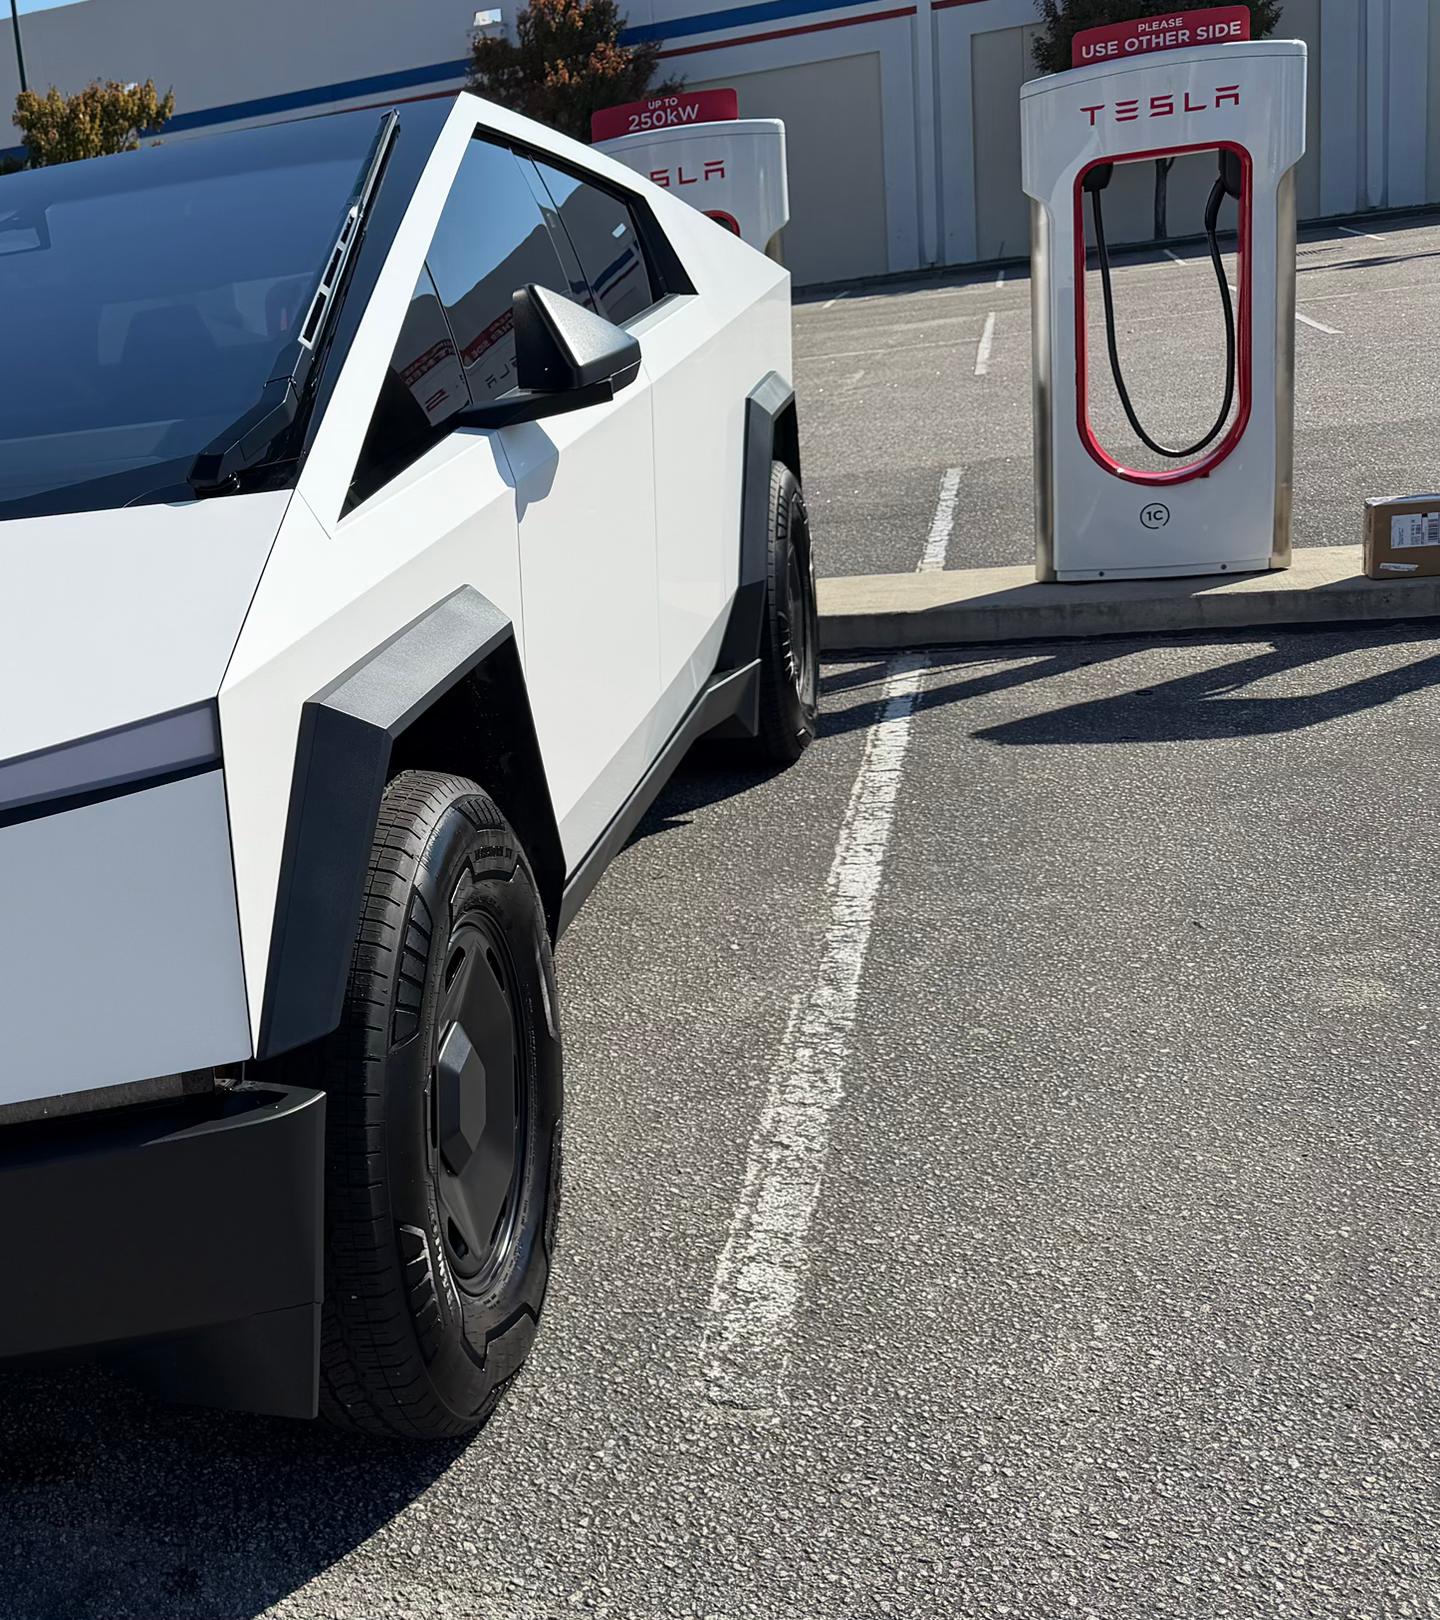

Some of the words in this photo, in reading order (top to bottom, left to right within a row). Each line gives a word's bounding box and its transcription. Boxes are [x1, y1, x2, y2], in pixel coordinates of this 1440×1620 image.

[1138, 17, 1183, 32] PLEASE
[1081, 40, 1119, 58] USE
[1124, 29, 1190, 52] OTHER
[1196, 20, 1242, 41] SIDE
[628, 103, 700, 132] 250kW
[647, 99, 662, 110] UP
[663, 97, 678, 107] TO
[1079, 84, 1241, 126] TESLA
[650, 160, 726, 188] SLA
[1146, 510, 1164, 521] 1C
